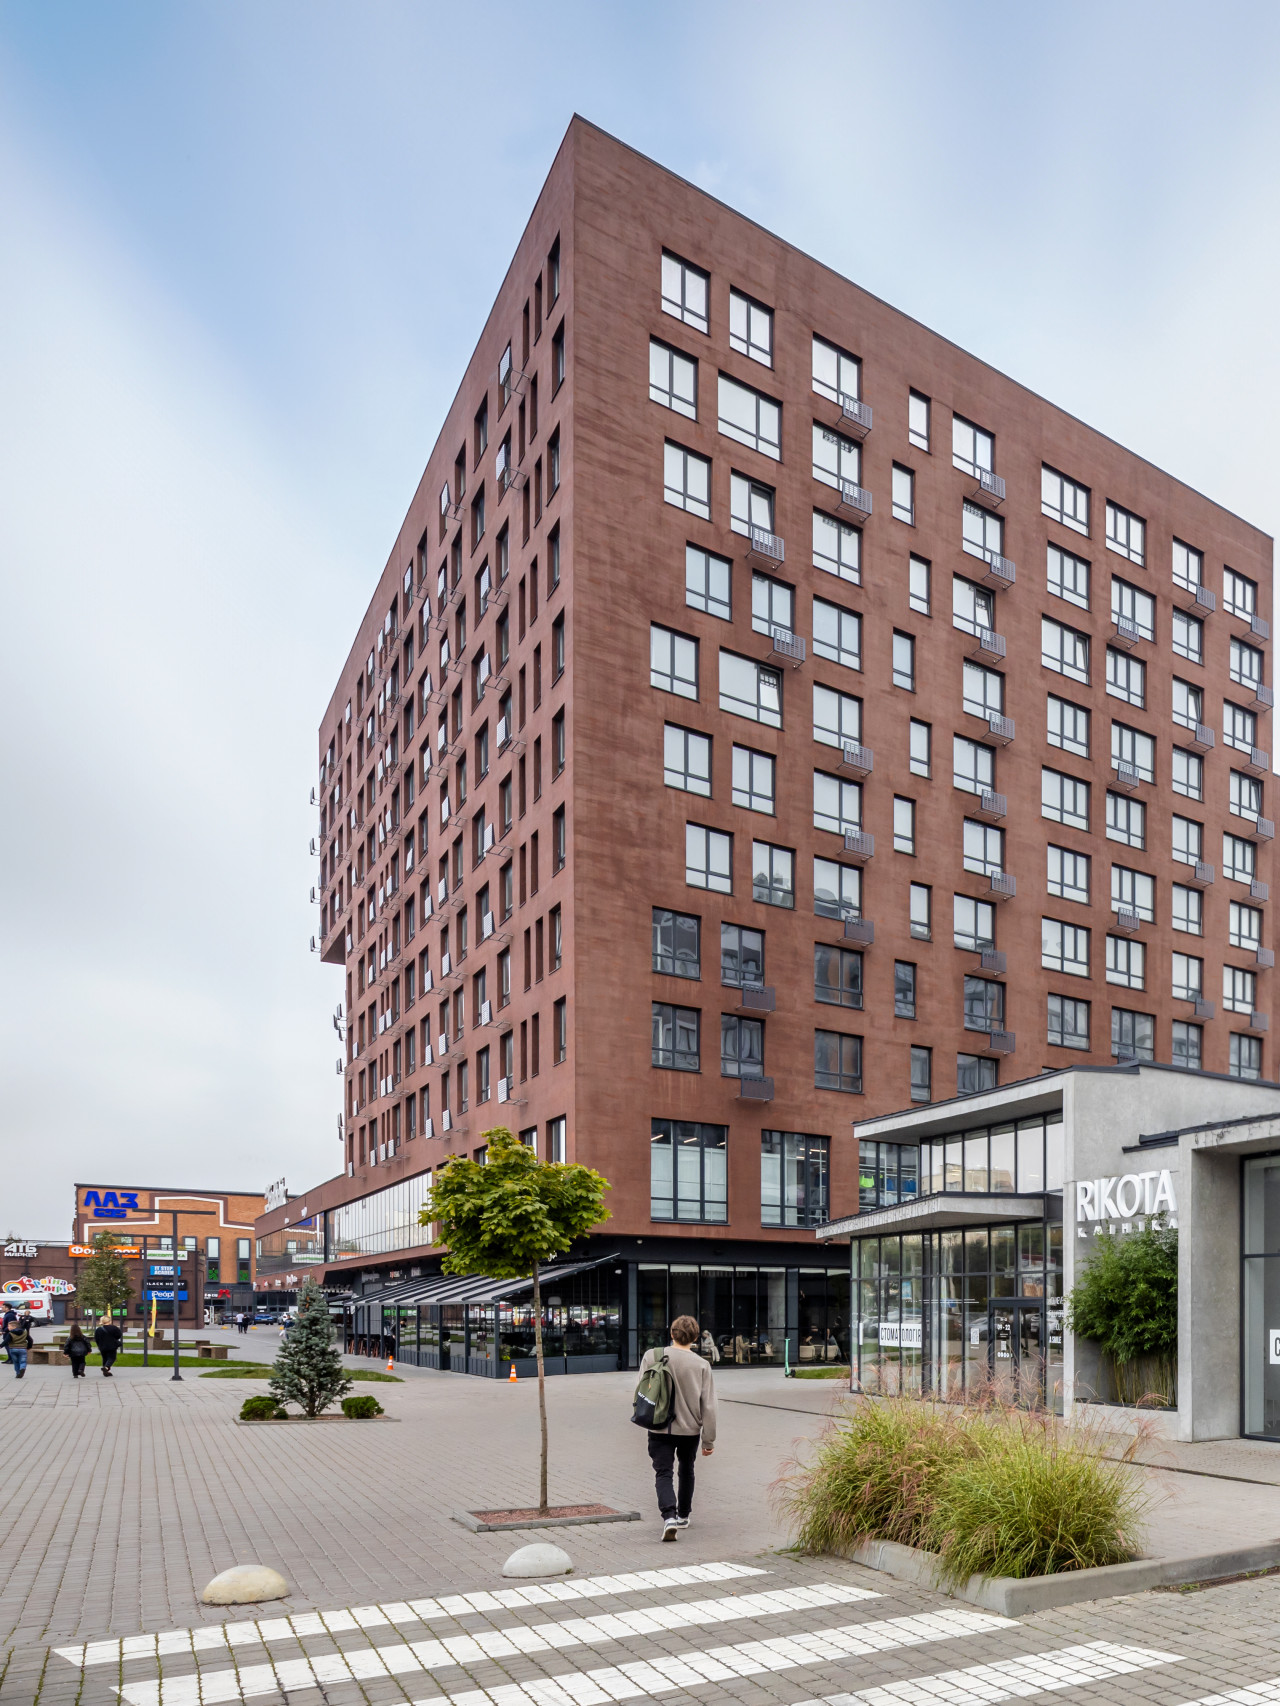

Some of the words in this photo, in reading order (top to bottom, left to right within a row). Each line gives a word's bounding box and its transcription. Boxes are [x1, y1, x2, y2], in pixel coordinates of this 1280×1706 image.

[83, 1190, 139, 1209] ЛАЗ
[1076, 1169, 1178, 1222] RIKOTA
[4, 1242, 37, 1254] АТБ
